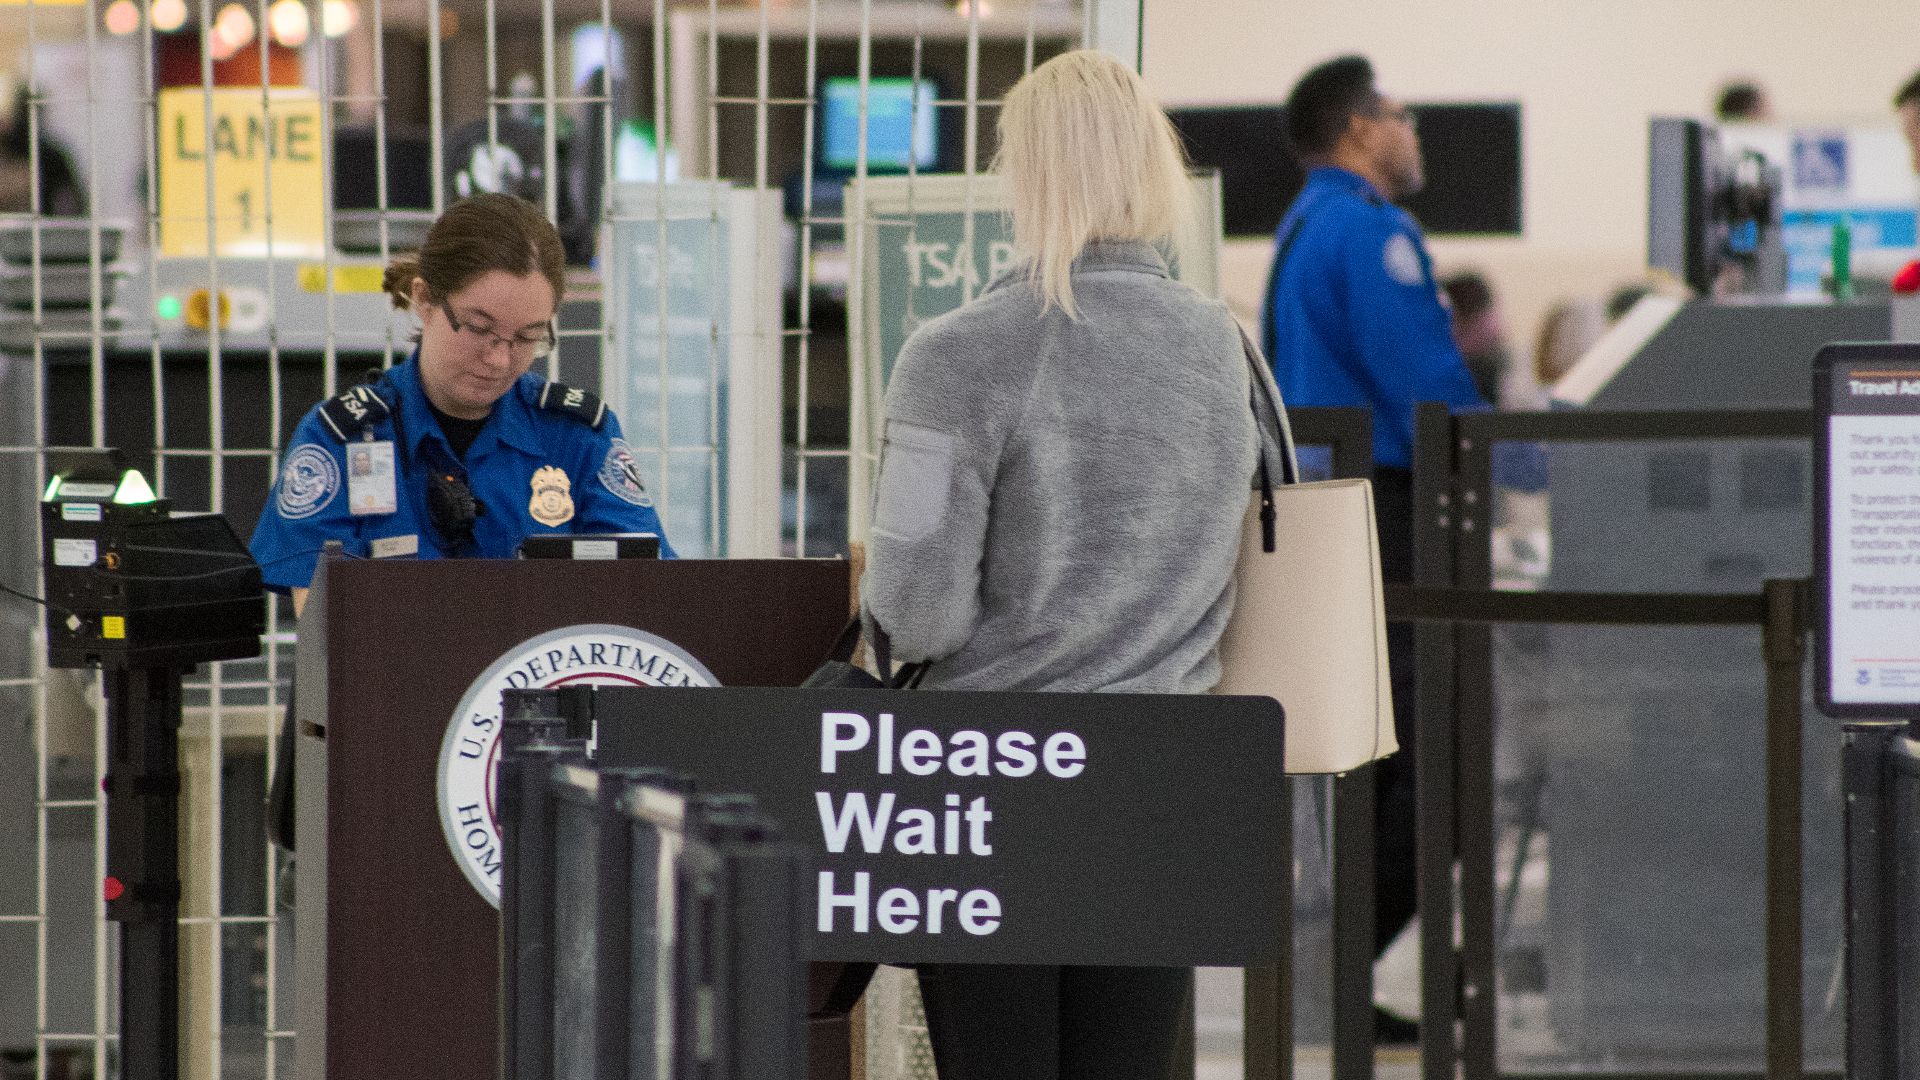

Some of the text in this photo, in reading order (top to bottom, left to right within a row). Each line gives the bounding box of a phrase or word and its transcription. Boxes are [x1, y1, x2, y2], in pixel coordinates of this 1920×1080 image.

[176, 114, 313, 161] LANE
[235, 188, 251, 231] 1
[904, 242, 980, 288] TSA
[340, 391, 368, 421] TSA
[563, 388, 585, 407] TSA
[1850, 379, 1897, 396] Travel
[1850, 433, 1884, 445] Thank
[459, 712, 499, 759] U.S.
[820, 711, 1087, 779] Please
[457, 803, 502, 887] HOM
[814, 791, 993, 856] Wait
[816, 870, 1002, 936] Here
